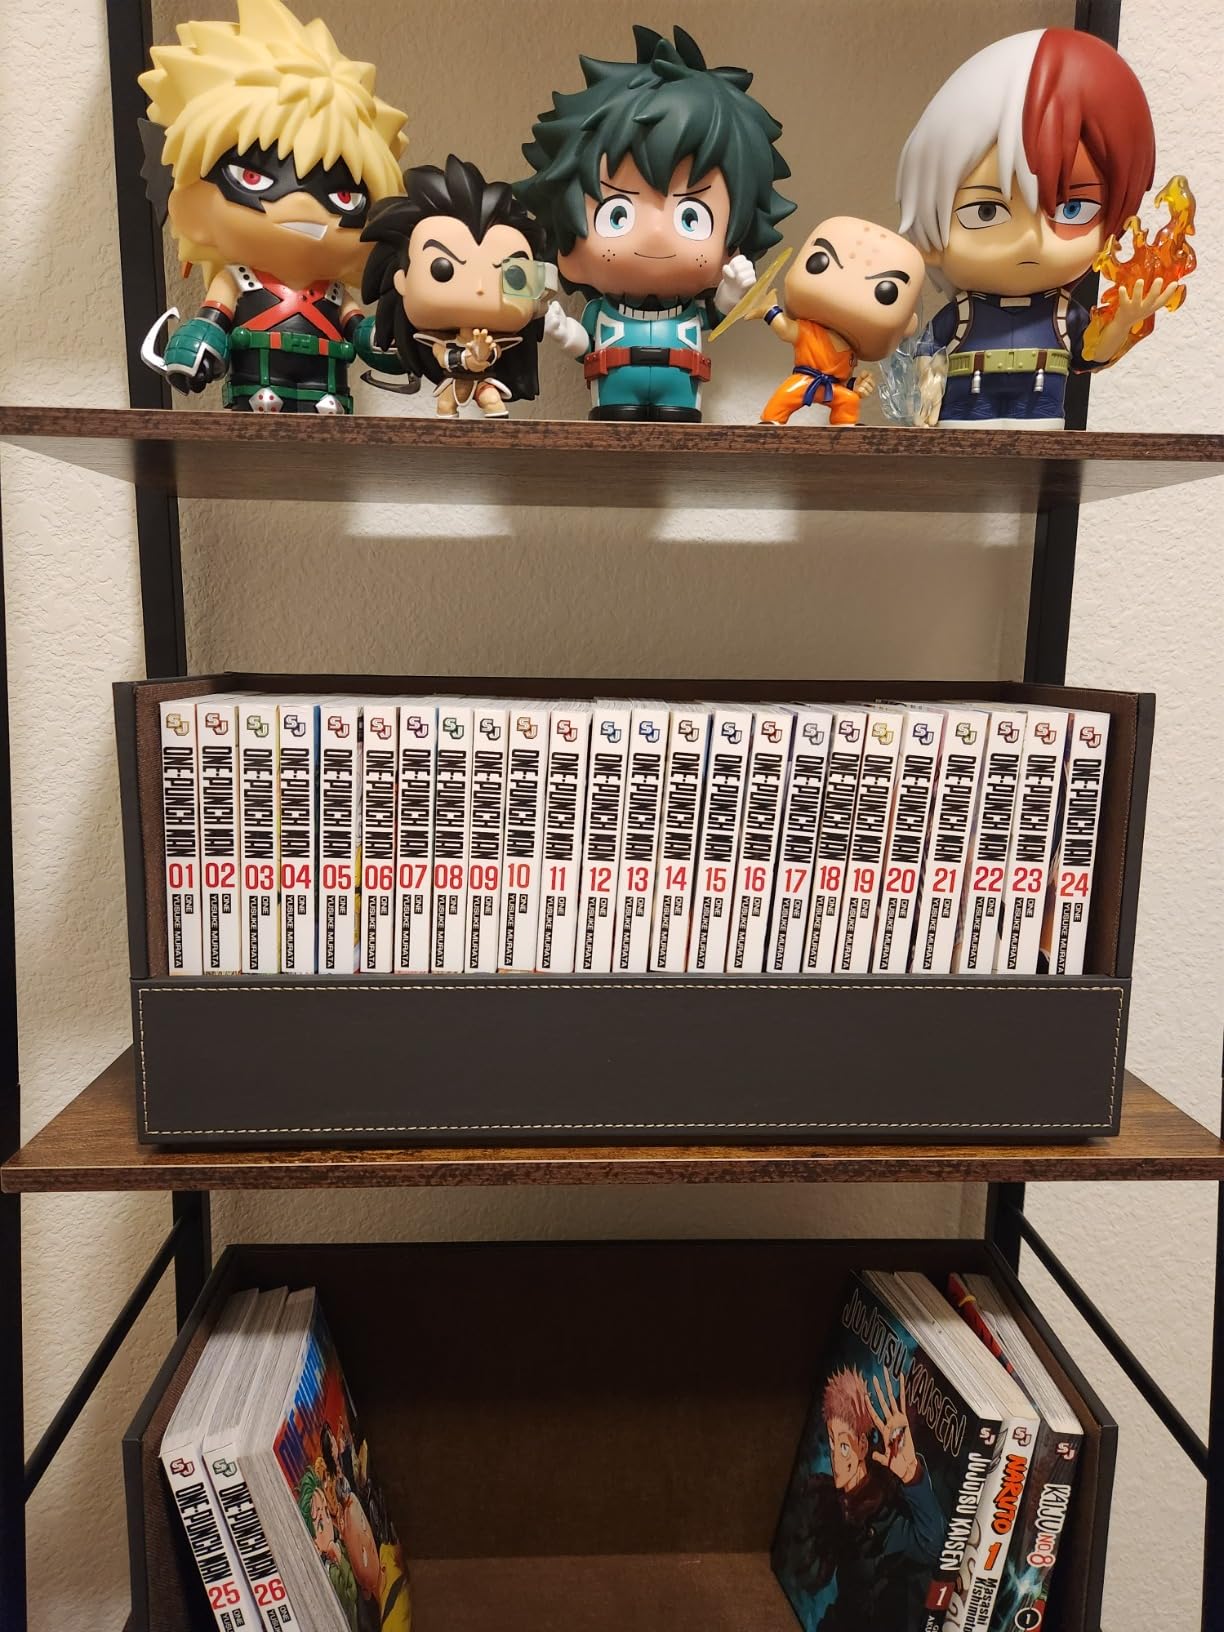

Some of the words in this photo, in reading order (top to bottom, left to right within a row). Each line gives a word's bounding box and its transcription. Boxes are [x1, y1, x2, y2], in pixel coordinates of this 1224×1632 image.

[164, 747, 194, 825] ONE-PUNCH
[202, 746, 233, 824] ONE-PUNCH
[244, 748, 272, 826] ONE-PUNCH
[281, 747, 309, 825] ONE-PUNCH
[324, 748, 352, 826] ONE-PUNCH
[365, 750, 394, 827] ONE-PUNCH
[401, 749, 430, 826] ONE-PUNCH
[437, 750, 466, 827] ONE-PUNCH
[473, 750, 503, 828] ONE-PUNCH
[508, 749, 540, 826] ONE-PUNCH
[547, 752, 579, 829] ONE-PUNCH
[590, 753, 622, 830] ONE-PUNCH
[628, 753, 661, 830] ONE-PUNCH
[667, 752, 700, 829] ONE-PUNCH
[708, 754, 741, 830] ONE-PUNCH
[747, 753, 782, 830] ONE-PUNCH
[787, 755, 824, 832] ONE-PUNCH
[823, 752, 859, 829] ONE-PUNCH
[855, 754, 893, 831] ONE-PUNCH
[896, 754, 932, 831] ONE-PUNCH
[938, 754, 977, 830] ONE-PUNCH
[982, 753, 1019, 830] ONE-PUNCH
[1019, 754, 1056, 831] ONE-PUNCH
[1066, 759, 1101, 835] ONE-PUNCH
[166, 830, 195, 858] MAN
[204, 829, 234, 857] MAN
[245, 831, 272, 858] MAN
[281, 830, 310, 857] MAN
[323, 831, 351, 858] MAN
[365, 832, 393, 860] MAN
[401, 831, 428, 858] MAN
[436, 832, 464, 859] MAN
[472, 832, 500, 860] MAN
[506, 830, 535, 858] MAN
[545, 833, 574, 861] MAN
[588, 834, 617, 861] MAN
[625, 834, 655, 861] MAN
[664, 833, 693, 861] MAN
[705, 835, 735, 862] MAN
[743, 834, 774, 862] MAN
[784, 836, 814, 863] MAN
[819, 833, 849, 861] MAN
[851, 836, 883, 863] MAN
[892, 836, 923, 863] MAN
[934, 835, 965, 862] MAN
[978, 835, 1009, 862] MAN
[1015, 836, 1046, 863] MAN
[1063, 839, 1093, 866] MAN
[168, 863, 194, 889] 01
[205, 862, 235, 888] 02
[245, 864, 274, 891] 03
[280, 863, 312, 889] 04
[322, 864, 352, 890] 05
[364, 864, 393, 891] 06
[399, 863, 428, 889] 07
[433, 864, 463, 890] 08
[469, 864, 499, 891] 09
[508, 863, 531, 889] 10
[550, 866, 566, 891] 11
[590, 867, 612, 893] 12
[627, 866, 649, 892] 13
[666, 865, 687, 891] 14
[706, 867, 727, 892] 15
[745, 866, 766, 892] 16
[785, 868, 807, 893] 17
[820, 865, 841, 891] 18
[854, 868, 875, 894] 19
[886, 867, 916, 894] 20
[932, 867, 957, 893] 21
[973, 866, 1004, 893] 22
[1012, 867, 1043, 893] 23
[1060, 872, 1089, 897] 24
[172, 895, 182, 929] YUSUKE
[185, 894, 193, 914] ONE
[209, 895, 219, 929] YUSUKE
[222, 894, 230, 914] ONE
[249, 897, 258, 931] YUSUKE
[261, 896, 270, 915] ONE
[286, 896, 294, 930] YUSUKE
[298, 895, 306, 915] ONE
[326, 896, 335, 930] YUSUKE
[339, 896, 347, 915] ONE
[367, 896, 376, 930] YUSUKE
[380, 896, 388, 915] ONE
[402, 895, 411, 929] YUSUKE
[414, 894, 423, 914] ONE
[436, 896, 445, 930] YUSUKE
[449, 895, 457, 915] ONE
[471, 897, 480, 930] YUSUKE
[484, 896, 493, 916] ONE
[506, 894, 516, 928] YUSUKE
[519, 894, 527, 913] ONE
[544, 897, 555, 931] YUSUKE
[557, 897, 566, 916] ONE
[586, 898, 597, 931] YUSUKE
[599, 898, 608, 917] ONE
[636, 897, 645, 917] ONE
[674, 896, 682, 916] ONE
[713, 897, 722, 917] ONE
[752, 897, 761, 917] ONE
[792, 899, 801, 919] ONE
[826, 897, 835, 916] ONE
[860, 899, 870, 918] ONE
[899, 899, 908, 918] ONE
[942, 899, 952, 918] ONE
[986, 898, 996, 917] ONE
[1025, 897, 1035, 917] ONE
[1074, 902, 1083, 922] ONE
[173, 930, 183, 968] MURATA
[210, 930, 219, 967] MURATA
[249, 932, 258, 969] MURATA
[286, 931, 294, 968] MURATA
[326, 931, 335, 968] MURATA
[367, 932, 375, 968] MURATA
[401, 930, 410, 967] MURATA
[435, 931, 444, 968] MURATA
[470, 932, 479, 968] MURATA
[504, 929, 514, 965] MURATA
[542, 932, 553, 968] MURATA
[583, 933, 594, 969] MURATA
[842, 1288, 907, 1381] JUJUTSU
[905, 1357, 967, 1457] KAISEN
[956, 1453, 991, 1514] JUJUTSU
[991, 1453, 1027, 1535] NARUTO
[175, 1482, 224, 1557] ONE-PUNCH
[1035, 1483, 1071, 1534] KAIJU
[939, 1518, 972, 1571] KAISEN
[984, 1542, 1002, 1571] 1
[198, 1552, 232, 1584] MAN
[243, 1550, 278, 1582] MAN
[208, 1581, 241, 1610] 25
[254, 1578, 286, 1607] 26
[936, 1586, 947, 1606] 1
[963, 1577, 987, 1632] Kishimoto
[976, 1577, 998, 1626] Masashi
[232, 1608, 245, 1627] ONE
[278, 1605, 292, 1623] ONE
